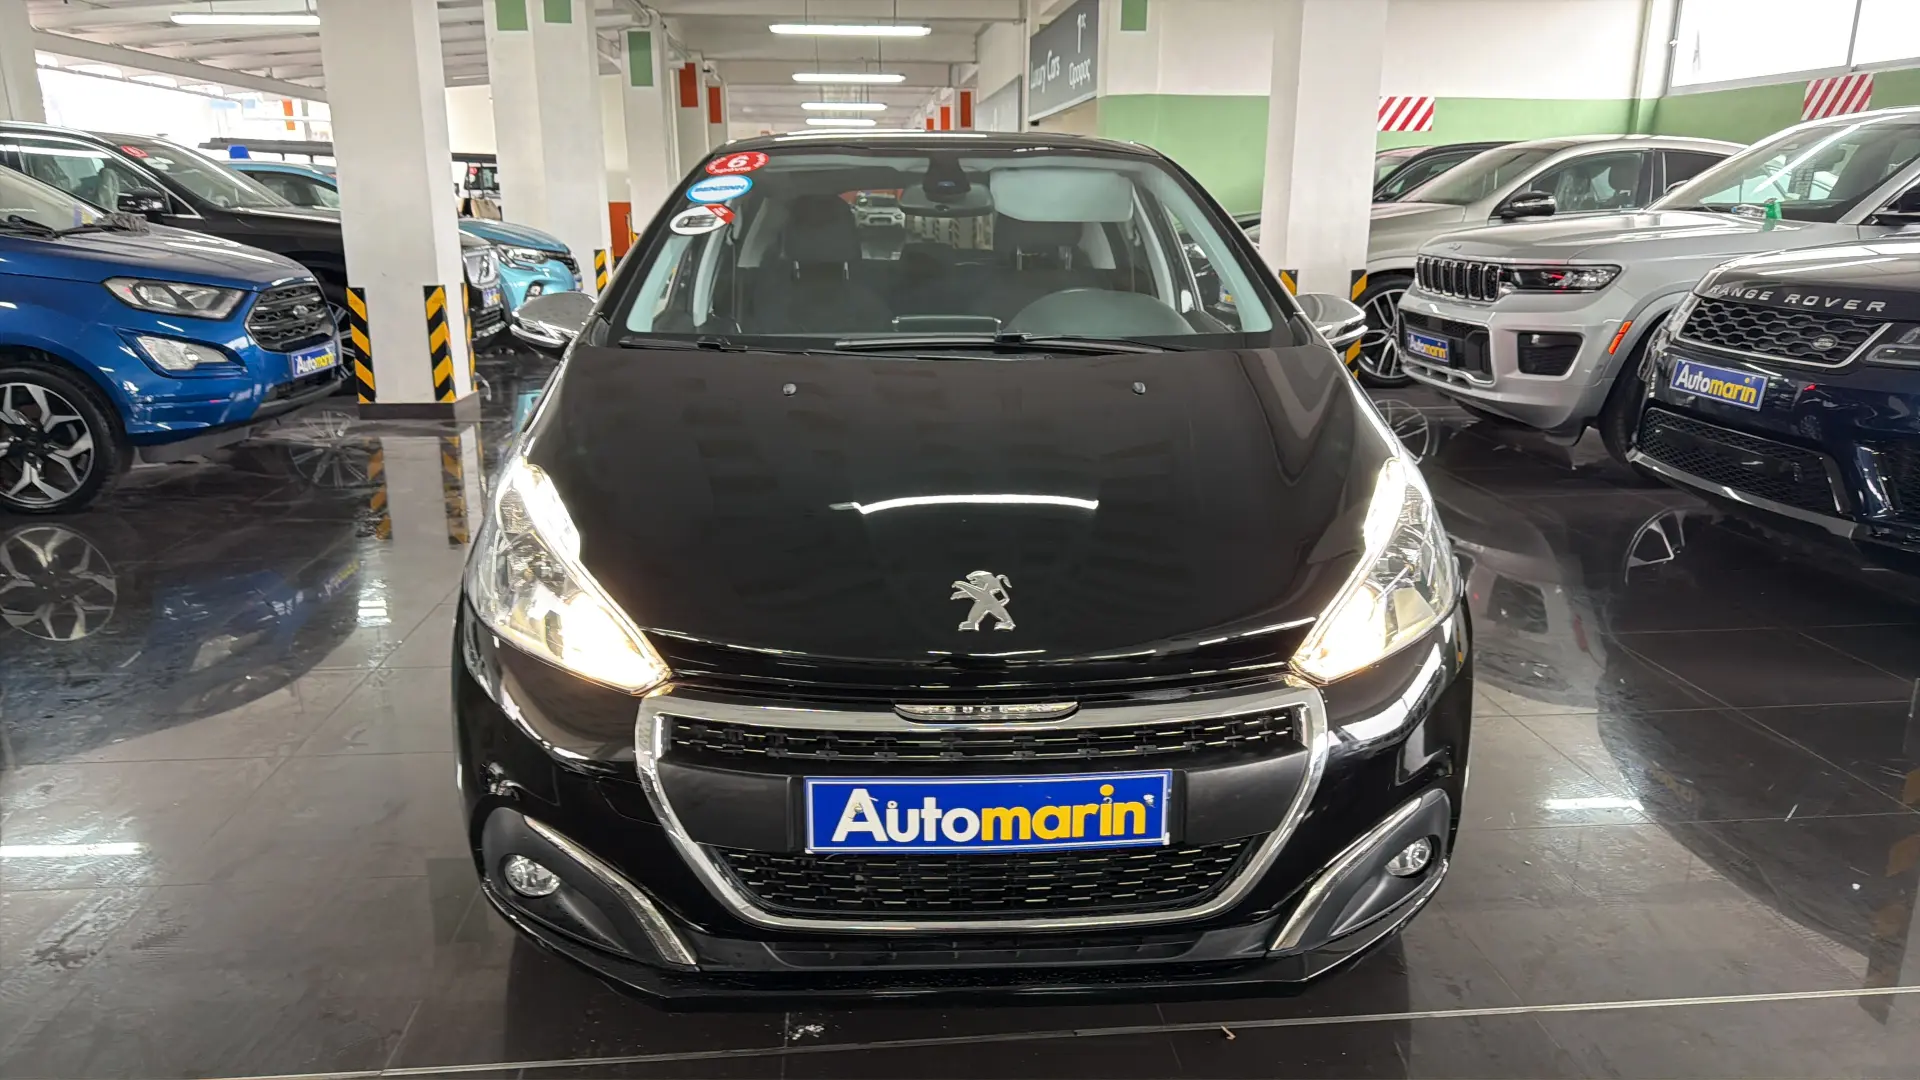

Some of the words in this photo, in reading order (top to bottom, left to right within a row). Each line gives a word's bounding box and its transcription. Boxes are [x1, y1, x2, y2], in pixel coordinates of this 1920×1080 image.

[1047, 50, 1060, 81] Cars
[728, 155, 749, 167] 6
[1709, 284, 1774, 301] RANGE
[1783, 293, 1887, 313] ROVER
[1674, 366, 1758, 405] Automarin
[831, 784, 1147, 843] Automarin
